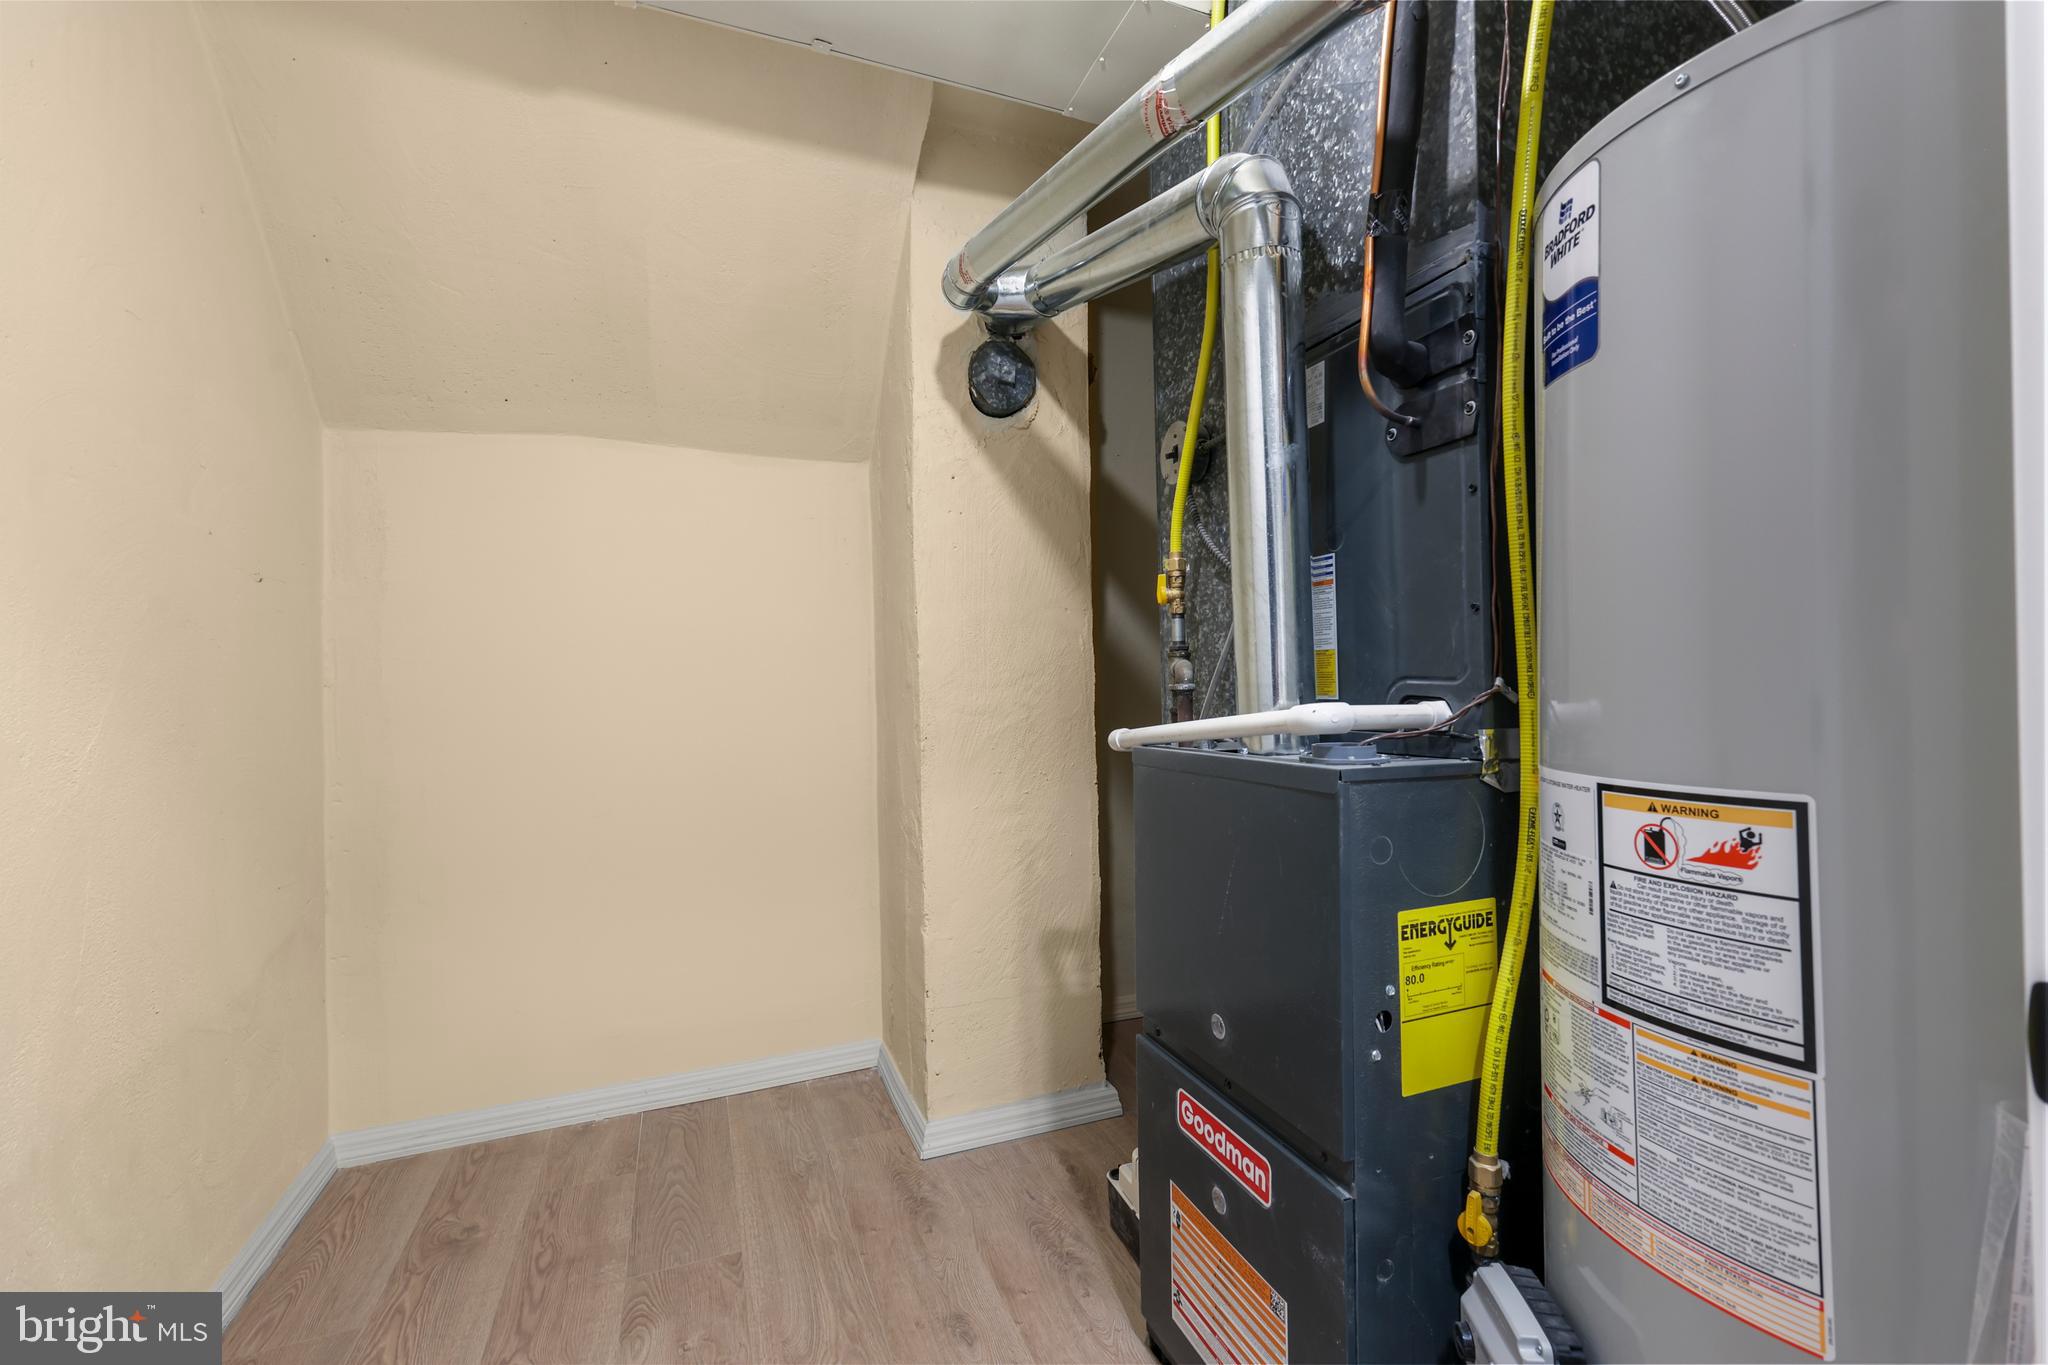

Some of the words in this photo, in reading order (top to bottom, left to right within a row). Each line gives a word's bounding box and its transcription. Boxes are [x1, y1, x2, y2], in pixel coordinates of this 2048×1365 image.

[1544, 204, 1596, 261] BRADFORD
[1551, 231, 1581, 269] WHITE
[1576, 301, 1594, 318] Best
[1660, 803, 1719, 819] WARNING
[1680, 867, 1715, 878] Flammable
[1717, 873, 1743, 882] Vapors
[1634, 876, 1647, 884] FIRE
[1648, 879, 1662, 887] AND
[1663, 882, 1704, 895] EXPLOSION
[1705, 890, 1738, 901] HAZARD
[1401, 911, 1494, 941] ENERGYGUIDE
[1411, 962, 1431, 972] Efficiency
[1432, 960, 1445, 970] Rating
[1405, 973, 1425, 986] 80.0
[1701, 1052, 1738, 1070] WARNING
[1701, 1079, 1739, 1097] WARNING
[1181, 1100, 1267, 1194] Goodman
